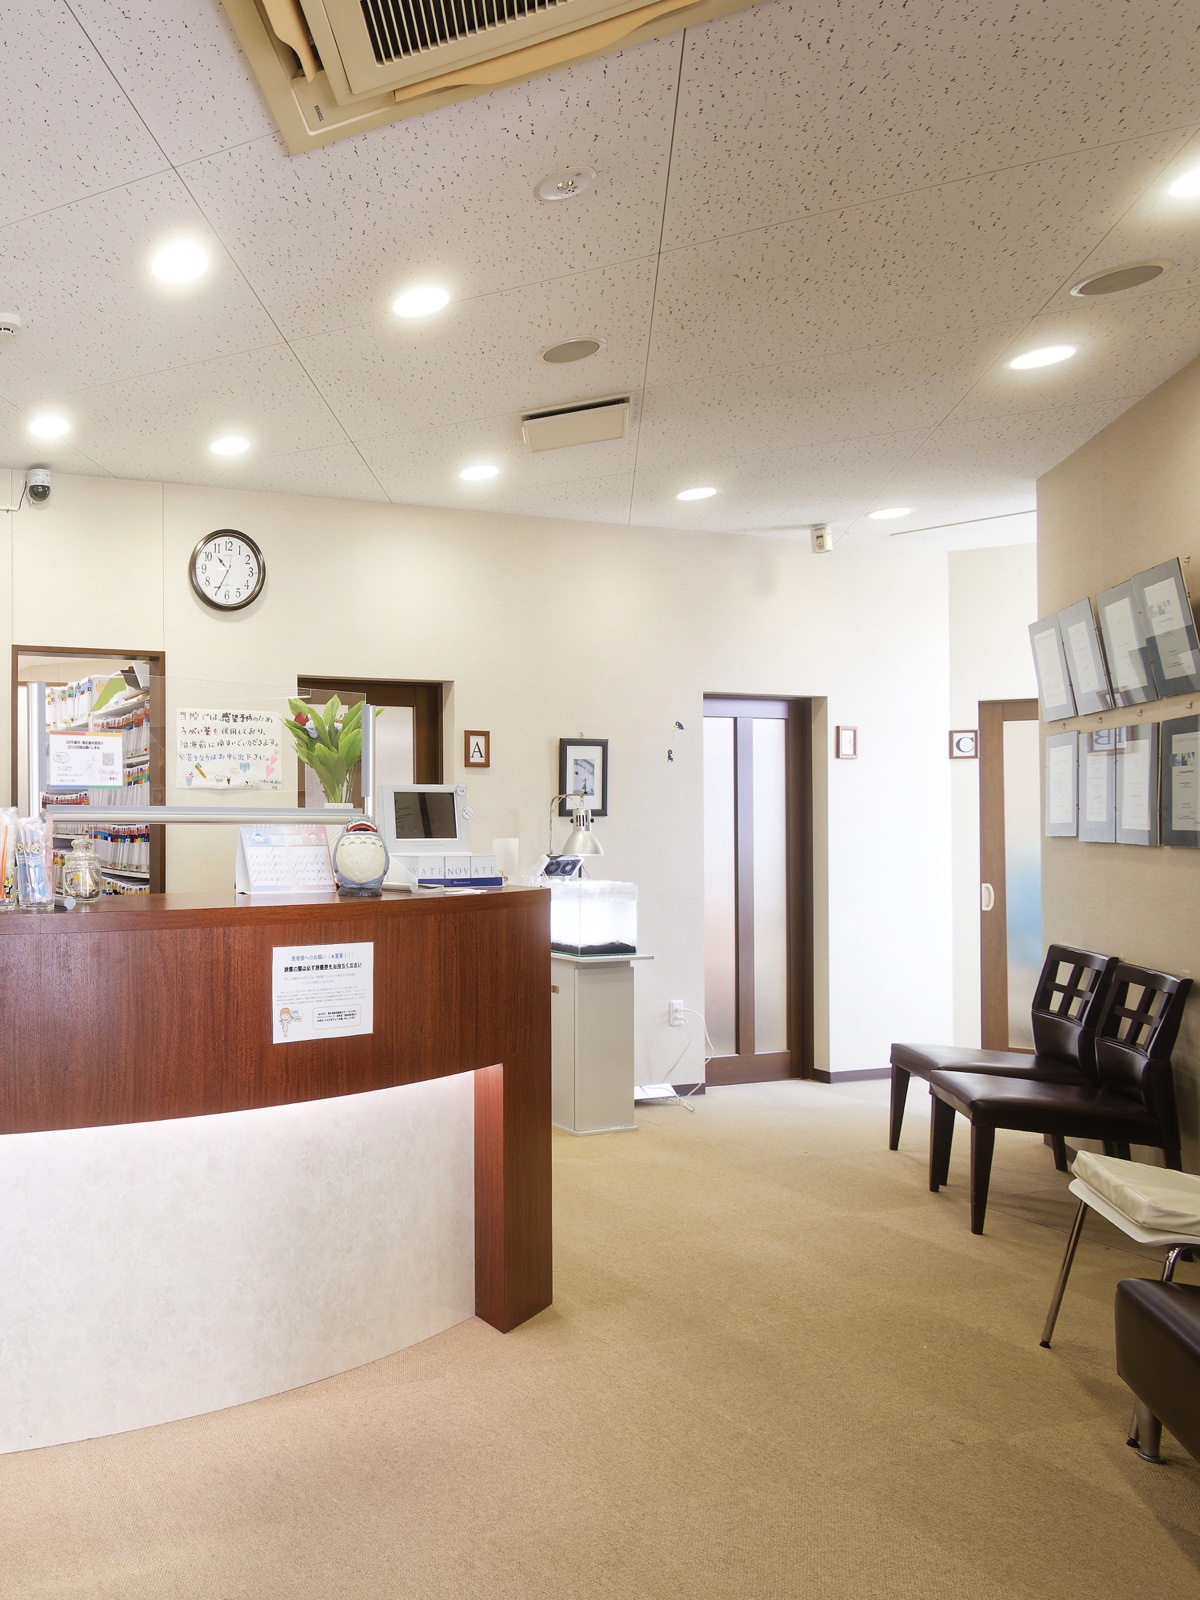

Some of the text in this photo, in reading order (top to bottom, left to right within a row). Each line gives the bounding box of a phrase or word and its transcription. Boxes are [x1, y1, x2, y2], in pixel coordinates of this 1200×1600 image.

[214, 543, 220, 553] 11
[225, 541, 233, 551] 12
[238, 546, 241, 555] 1
[204, 551, 212, 562] 10
[245, 555, 250, 564] 2
[201, 564, 207, 574] 9
[248, 567, 254, 577] 3
[205, 576, 210, 586] 8
[244, 580, 249, 590] 4
[214, 586, 220, 596] 7
[224, 590, 230, 600] 6
[236, 588, 241, 598] 5
[471, 741, 484, 758] A
[956, 737, 974, 753] C
